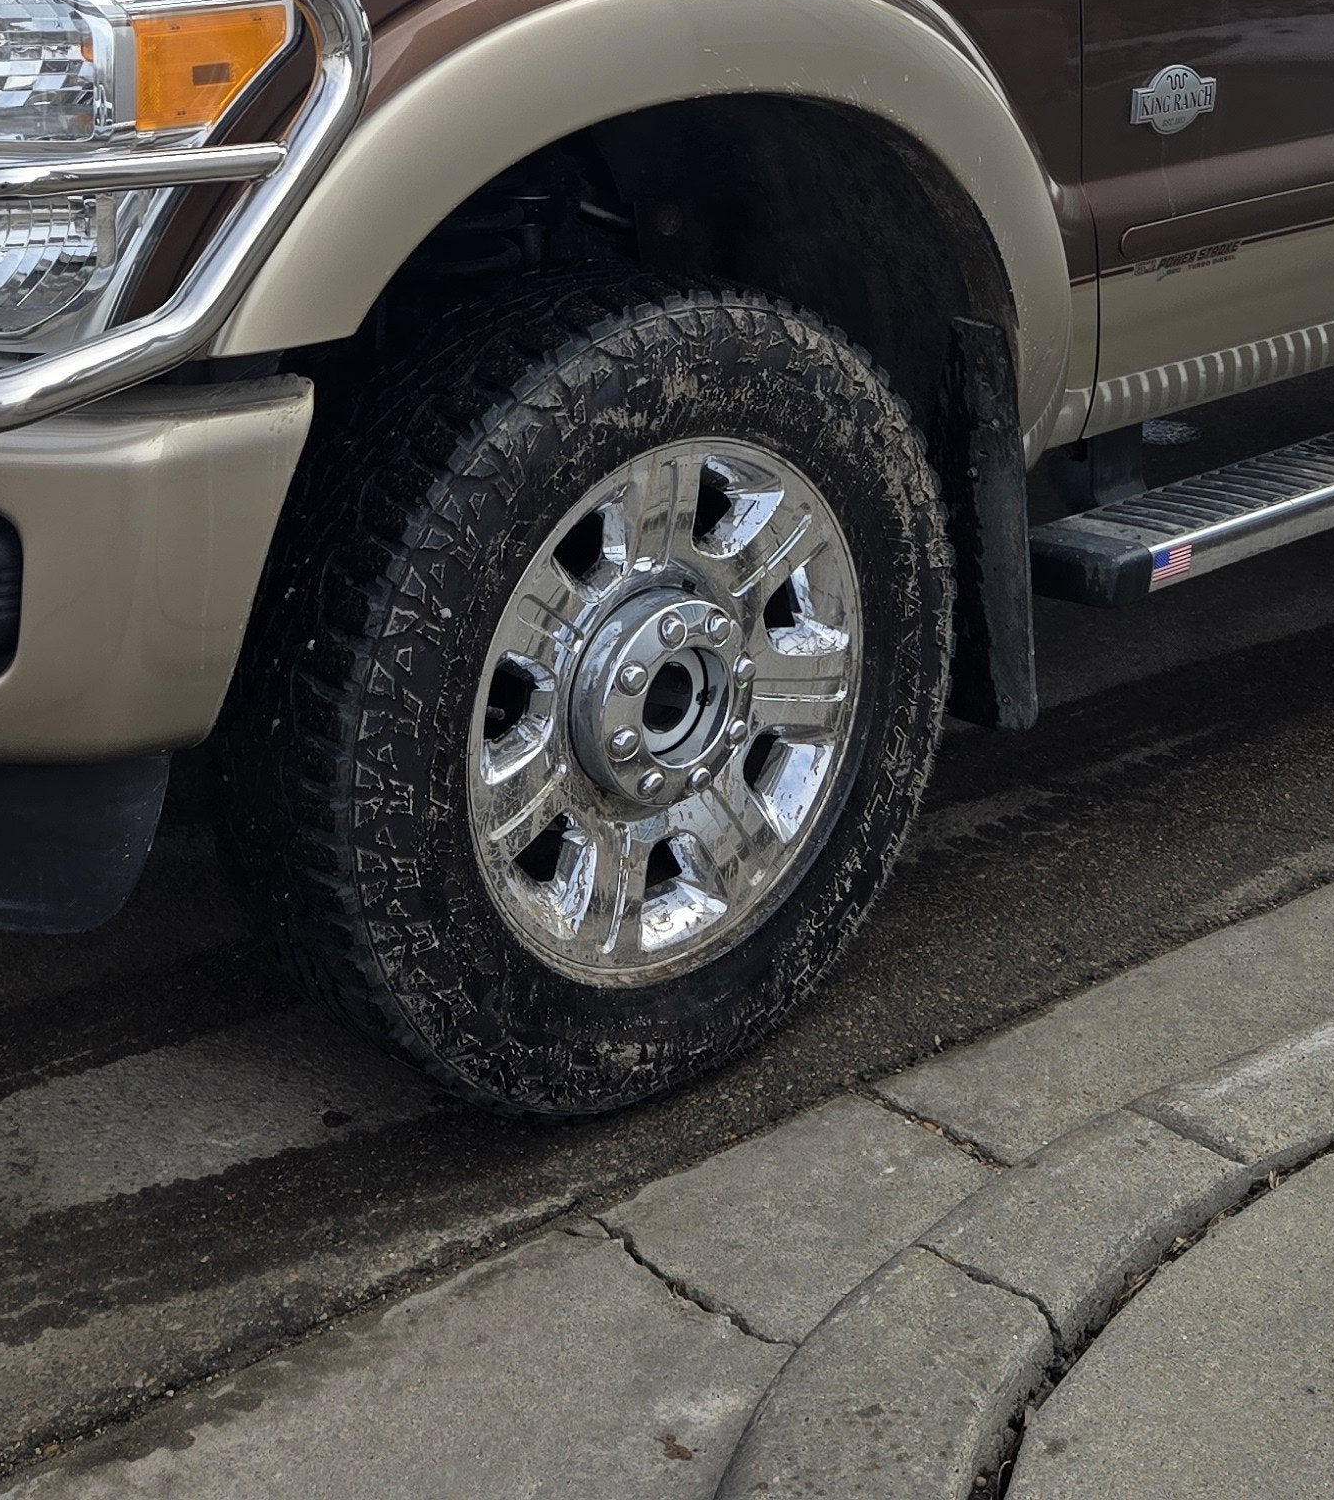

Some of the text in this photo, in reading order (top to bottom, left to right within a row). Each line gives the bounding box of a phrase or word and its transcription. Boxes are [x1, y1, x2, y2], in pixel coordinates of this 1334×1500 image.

[1141, 85, 1212, 116] KING RANCH
[1157, 250, 1198, 270] POWER
[1196, 242, 1240, 261] STROKE
